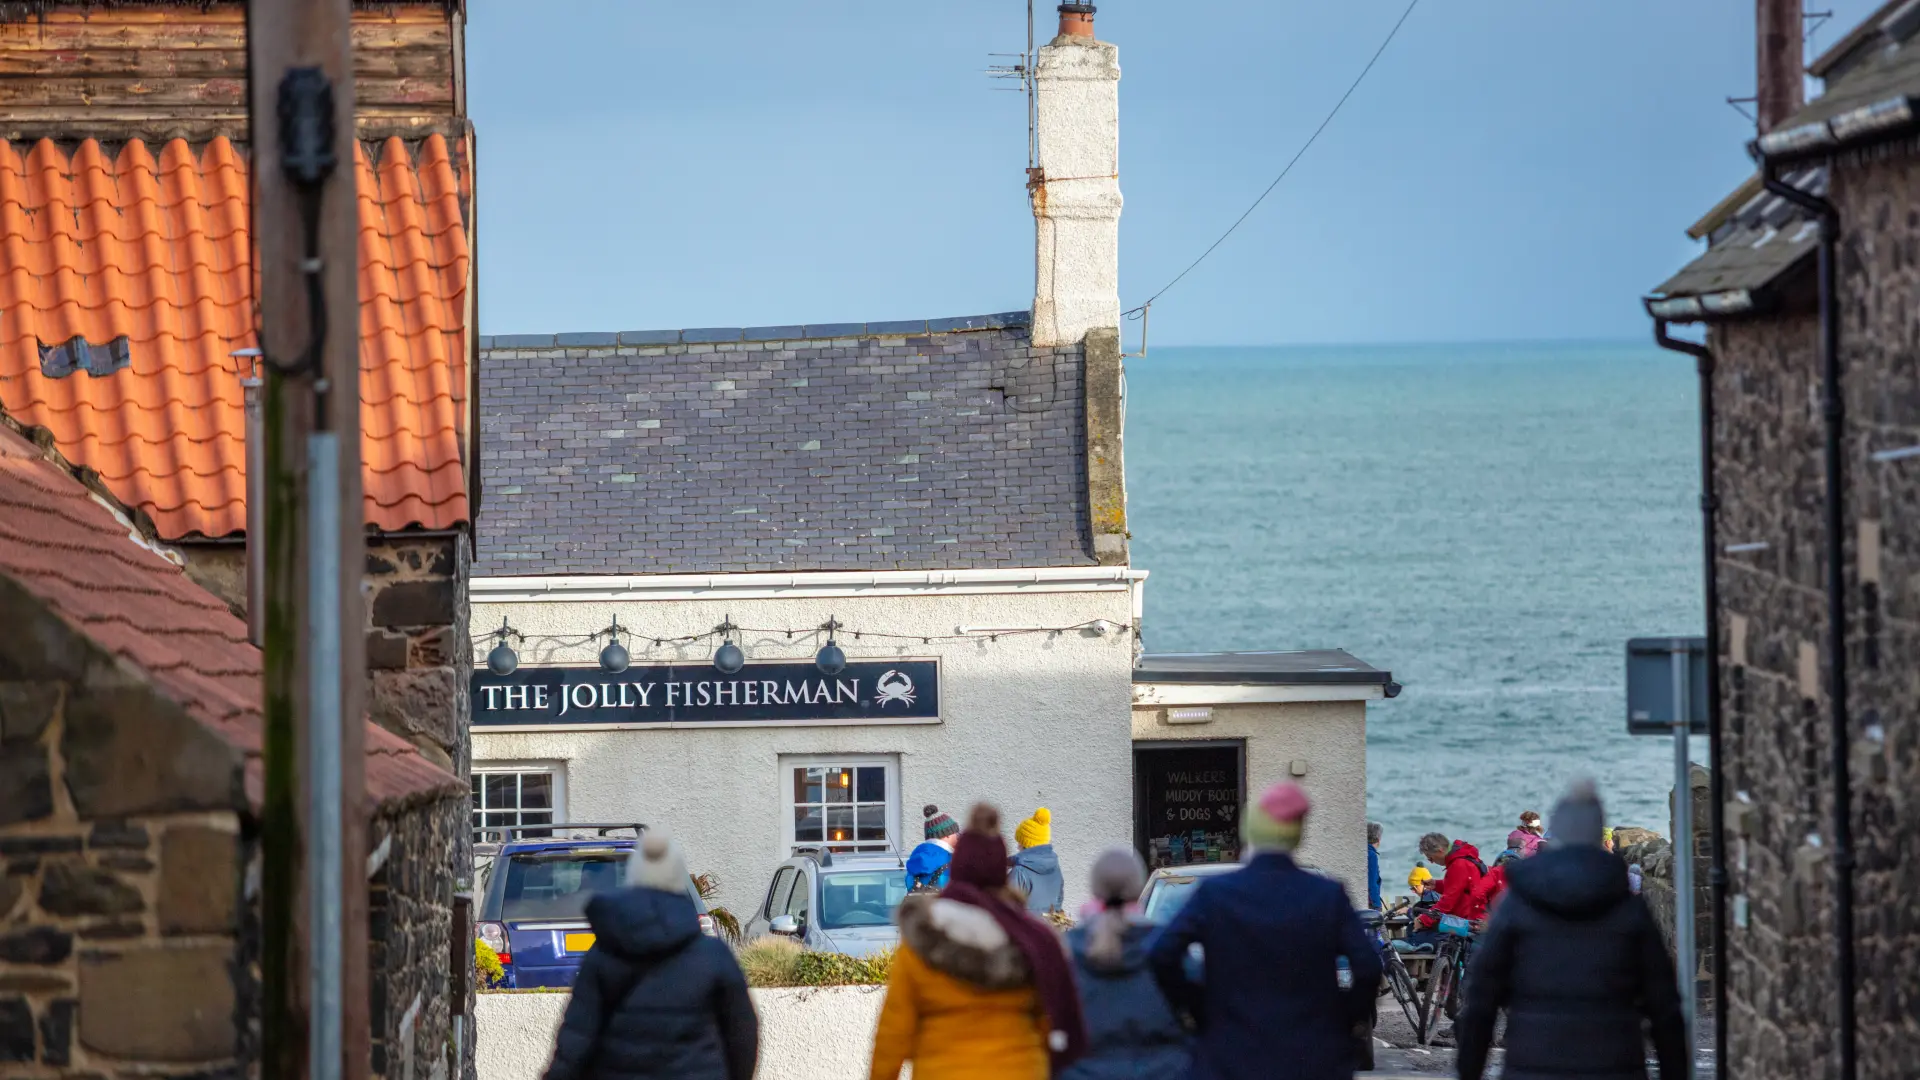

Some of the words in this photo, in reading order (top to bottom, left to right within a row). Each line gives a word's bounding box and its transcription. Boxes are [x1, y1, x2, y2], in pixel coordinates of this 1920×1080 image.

[480, 684, 549, 710] THE
[558, 682, 656, 716] JOLLY
[664, 678, 860, 707] FISHERMAN
[1166, 771, 1226, 783] WALKERS
[1165, 789, 1204, 802] MUDDY
[1208, 789, 1239, 801] BOOT
[1166, 808, 1176, 820] &
[1180, 808, 1211, 820] DOGS
